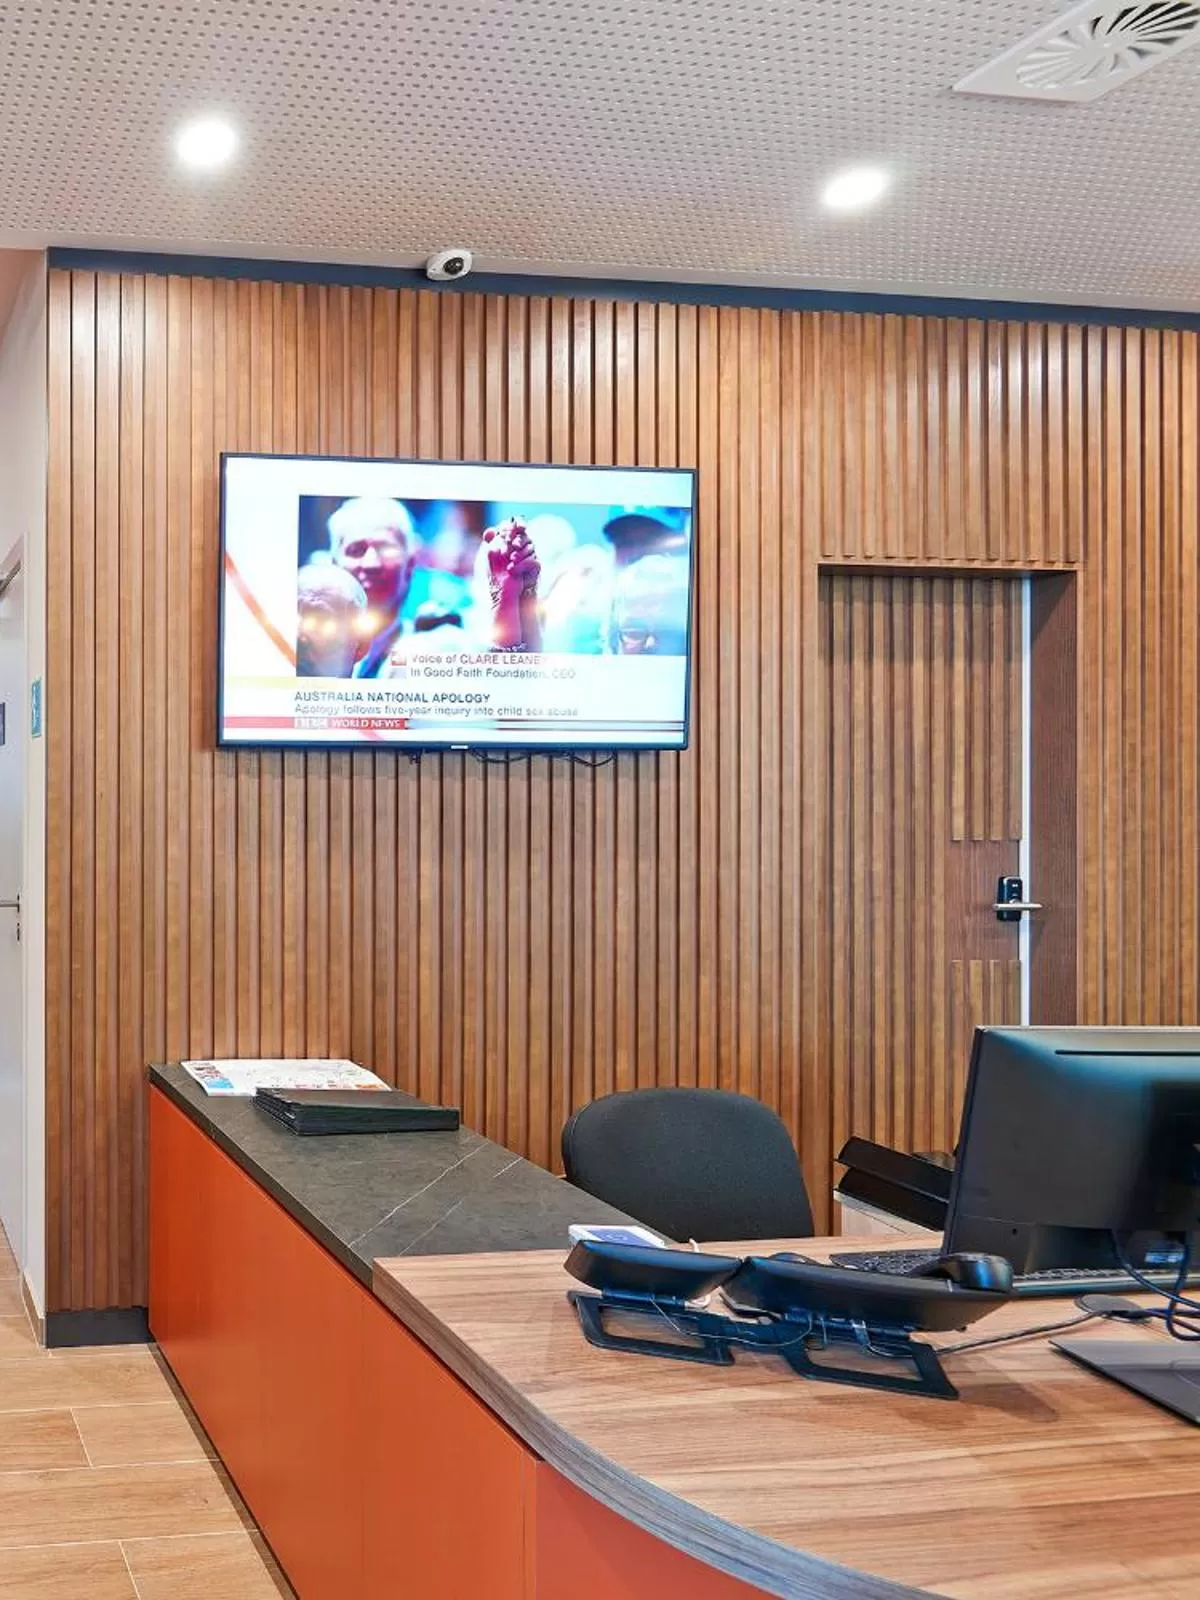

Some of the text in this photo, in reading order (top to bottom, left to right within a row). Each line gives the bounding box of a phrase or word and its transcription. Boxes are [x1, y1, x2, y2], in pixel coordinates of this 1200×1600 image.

[412, 653, 442, 664] Voice
[446, 653, 457, 664] of
[460, 654, 499, 664] CLARE
[410, 667, 421, 677] In
[424, 667, 453, 677] Good
[457, 667, 482, 677] Faith
[294, 691, 490, 704] AUSTRALIA NATIONAL APOLOGY
[294, 704, 339, 715] Apology
[343, 704, 381, 714] follows
[385, 705, 431, 717] five-year
[435, 706, 471, 717] inquiry
[474, 706, 493, 716] into
[497, 707, 522, 716] child
[332, 719, 369, 729] WORLD
[371, 720, 401, 729] NEWS
